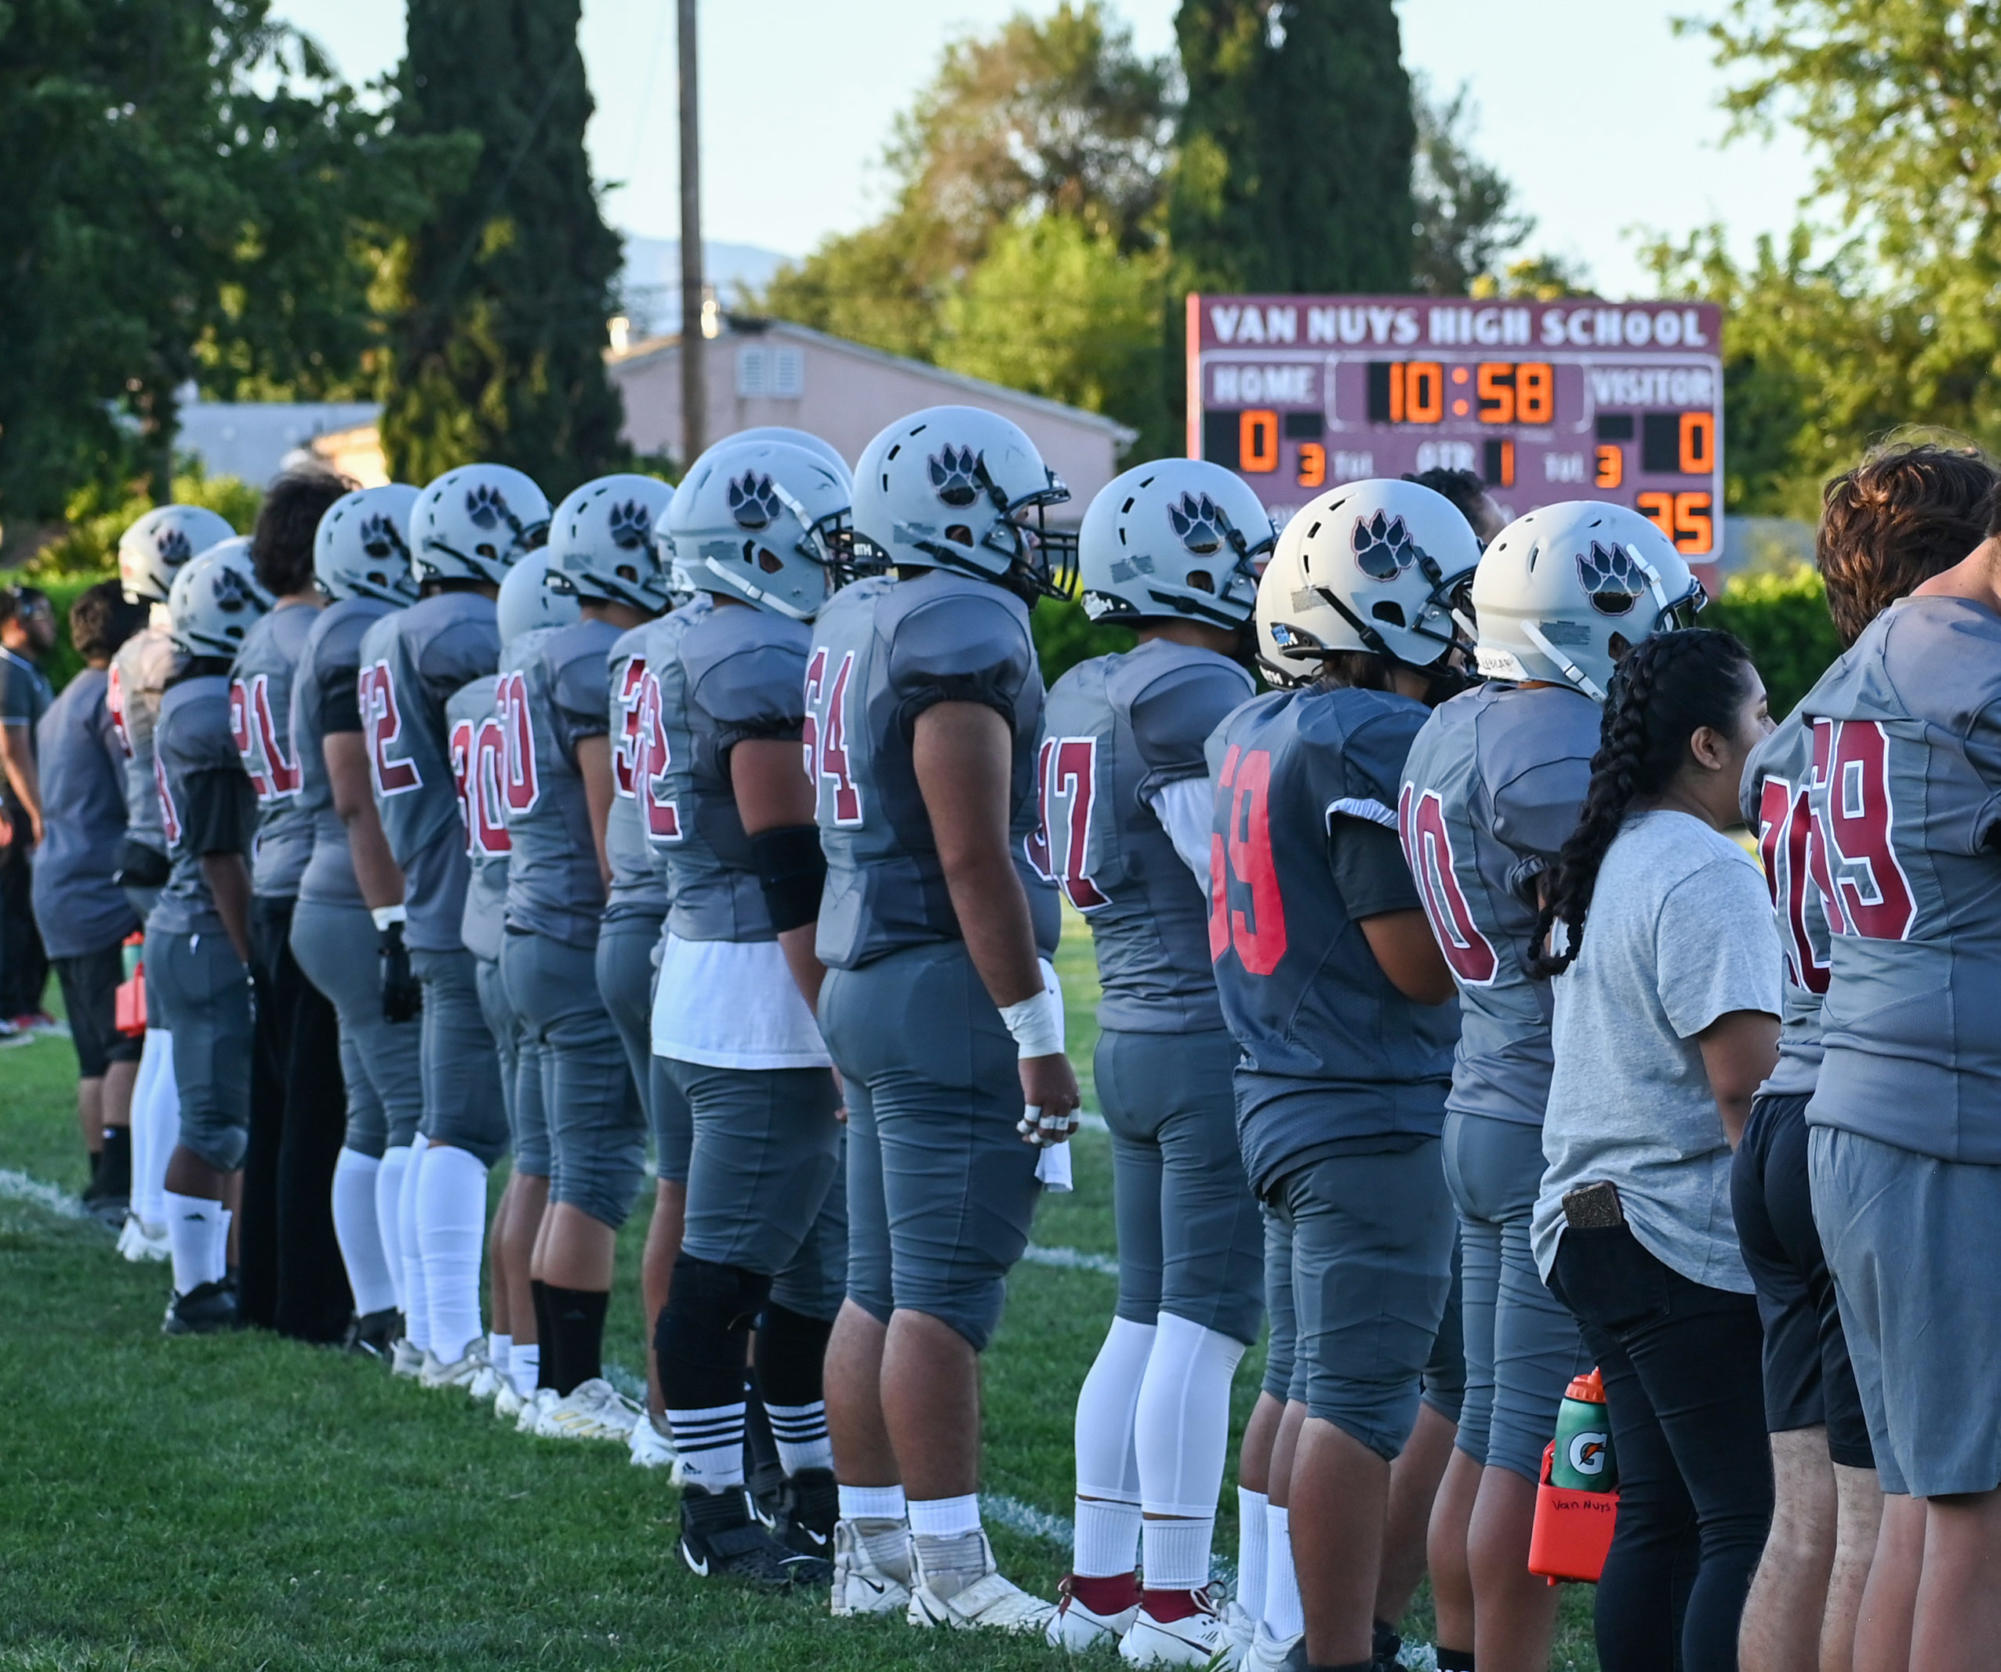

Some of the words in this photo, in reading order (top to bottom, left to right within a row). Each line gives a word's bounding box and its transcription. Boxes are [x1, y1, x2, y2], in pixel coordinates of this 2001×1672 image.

[1210, 305, 1298, 344] VAN
[1307, 306, 1420, 345] NUYS
[1429, 306, 1532, 345] HIGH
[1540, 307, 1708, 347] SCHOOL
[1213, 364, 1316, 404] HOME
[1389, 361, 1554, 424] 10:58
[1591, 367, 1713, 406] VISITOR
[1239, 409, 1278, 473] 0
[1500, 439, 1515, 487] 1
[1679, 411, 1714, 475] 0
[1297, 442, 1326, 488] 3
[1595, 444, 1623, 489] 3
[1568, 1431, 1608, 1475] G
[1552, 1500, 1580, 1511] Van
